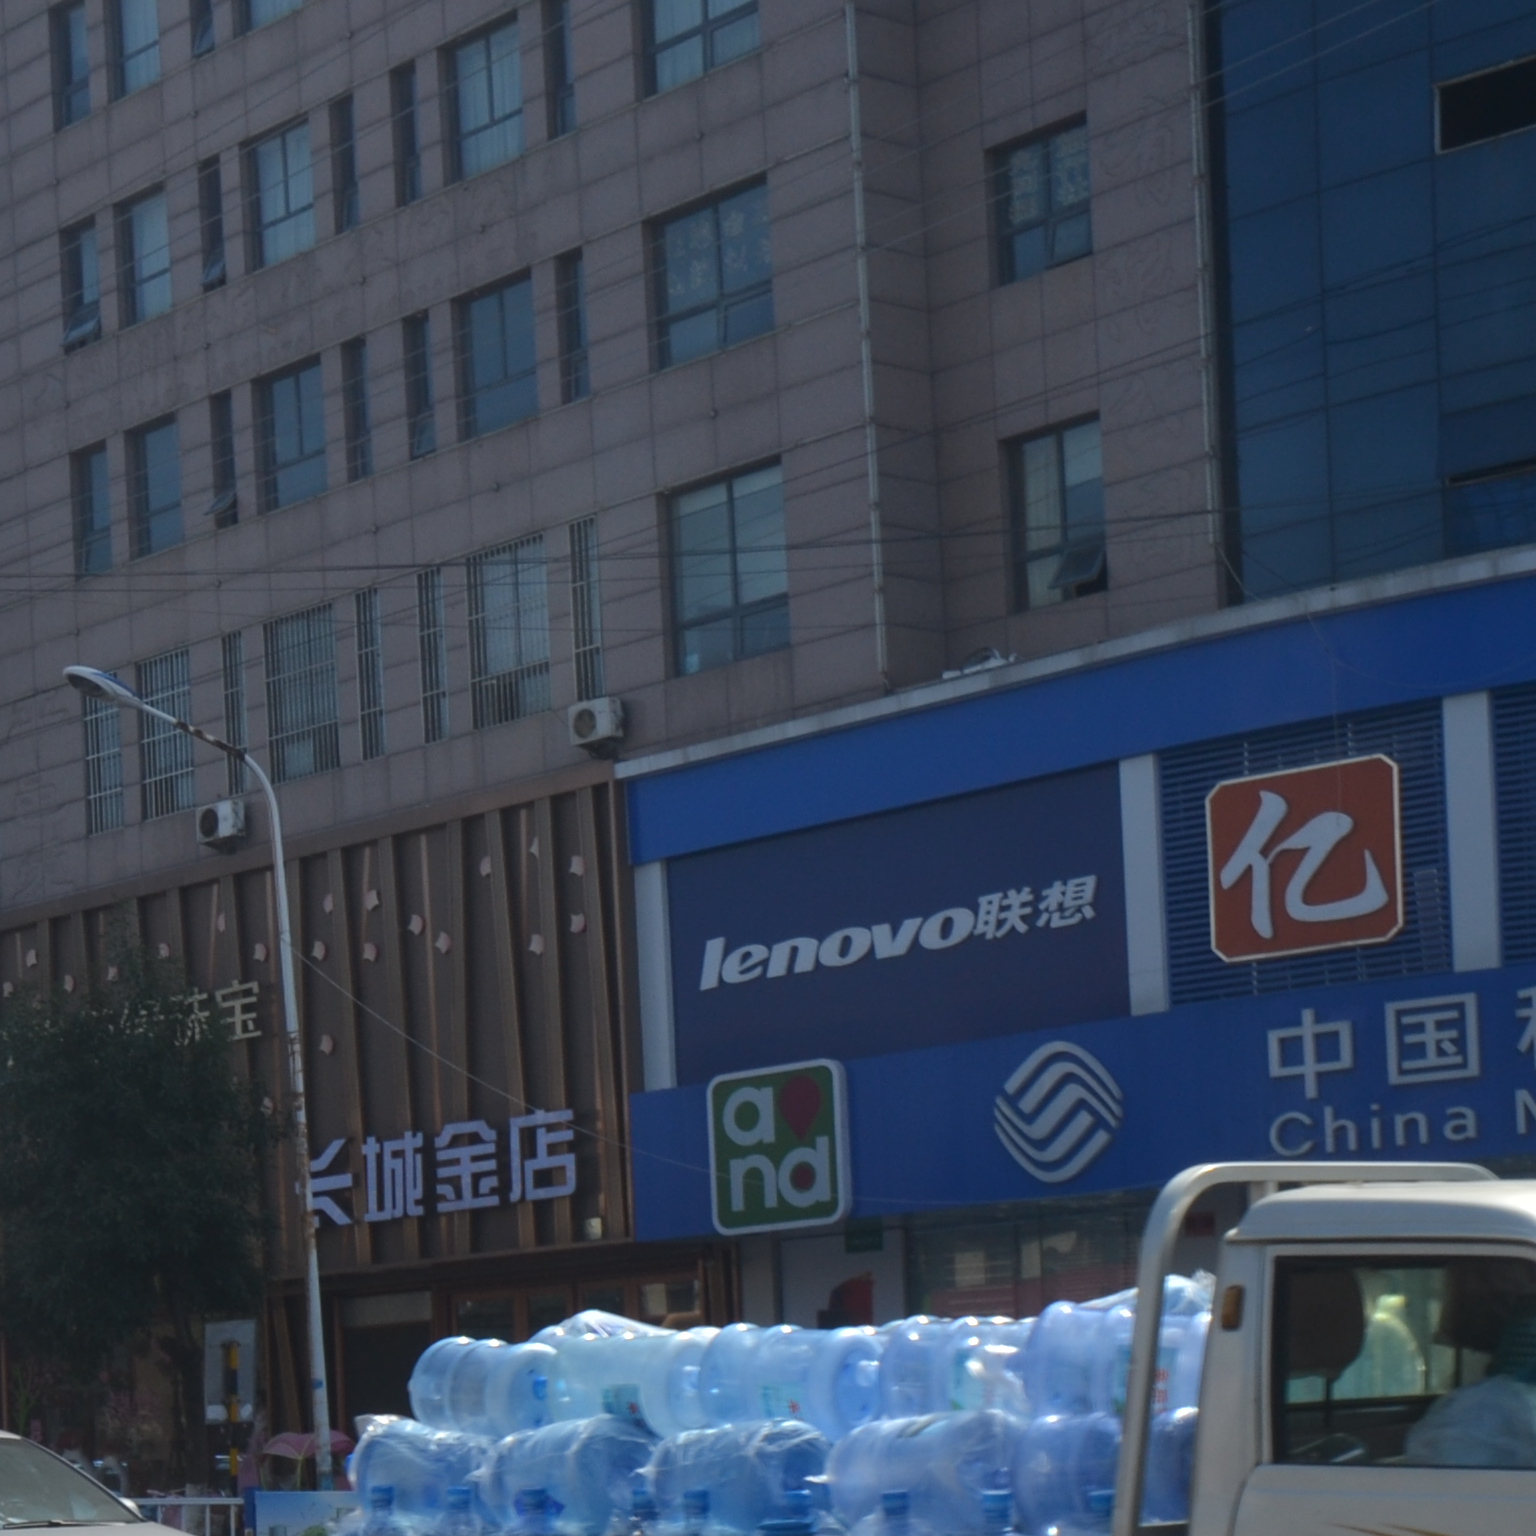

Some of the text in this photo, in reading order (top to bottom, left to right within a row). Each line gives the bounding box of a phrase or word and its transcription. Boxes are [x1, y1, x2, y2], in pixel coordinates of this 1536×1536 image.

[1220, 790, 1389, 939] 亿
[1268, 985, 1536, 1099] 中国
[295, 1108, 576, 1228] 长城金店
[1269, 1103, 1478, 1156] China
